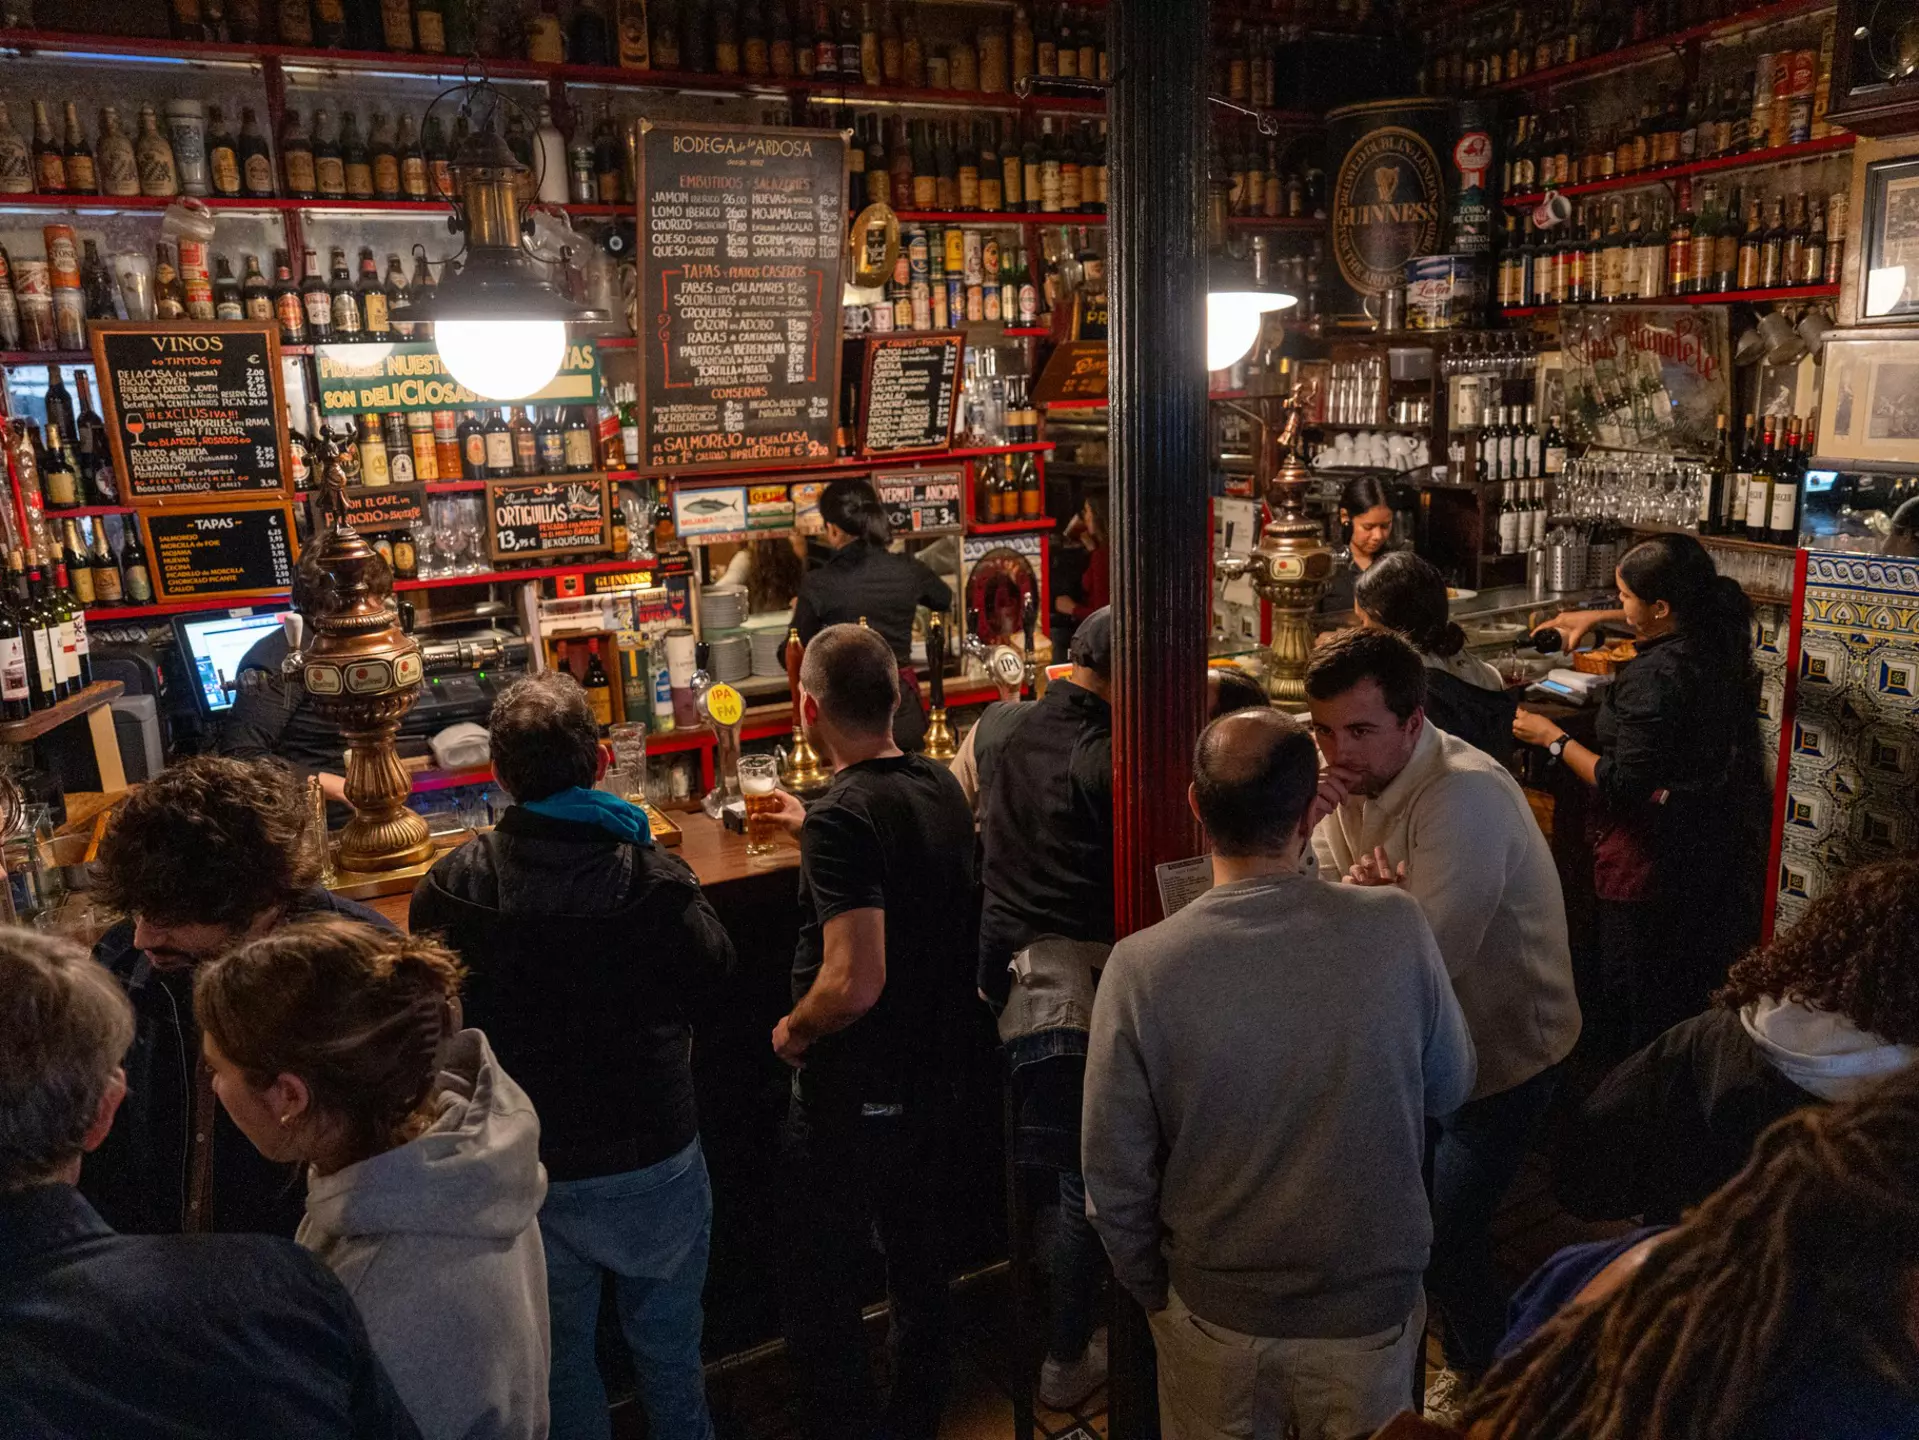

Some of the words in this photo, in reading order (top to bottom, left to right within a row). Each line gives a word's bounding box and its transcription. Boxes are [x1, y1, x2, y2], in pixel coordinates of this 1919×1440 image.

[673, 136, 737, 154] BODEGA
[755, 140, 813, 158] ARDOSA
[680, 175, 743, 189] EMBUTIDOS
[651, 192, 689, 203] JAMON
[752, 194, 786, 204] HUEVAS
[652, 206, 682, 217] LOMO
[686, 207, 720, 218] IBERICO
[752, 208, 792, 220] MOJAMA
[1340, 201, 1439, 226] GUINNESS
[1459, 205, 1484, 214] LOMO
[651, 219, 692, 231] CHORIZO
[781, 223, 813, 232] BACALAO
[652, 234, 686, 245] QUESO
[687, 236, 719, 245] CURADO
[753, 235, 785, 246] CECINA
[652, 245, 687, 257] QUESO
[753, 247, 785, 257] JAMON
[792, 247, 816, 258] PATO
[681, 264, 720, 279] TAPAS
[729, 267, 759, 278] PLATOS
[761, 265, 806, 278] CASEROS
[681, 282, 713, 294] FABES
[731, 282, 784, 294] CALAMARES
[674, 294, 737, 306] SOLOMILLITOS
[680, 307, 732, 319] CROQUETAS
[694, 319, 728, 331] CAZON
[739, 319, 774, 331] ADOBO
[152, 336, 224, 352] VINOS
[687, 332, 727, 344] RABAS
[738, 332, 783, 342] CANTABRIA
[680, 345, 722, 357] PALITOS
[733, 343, 786, 356] BERENJENA
[165, 356, 208, 366] TINTOS
[247, 354, 260, 364] €
[690, 356, 735, 367] BRANDADA
[743, 355, 775, 364] BACALAO
[144, 369, 173, 379] CASA
[698, 365, 737, 377] TORTILLA
[742, 364, 768, 374] PATATA
[119, 377, 150, 387] RIOJA
[154, 377, 187, 386] JOVEN
[694, 376, 738, 386] EMPANADA
[746, 374, 772, 384] BONITO
[163, 385, 190, 393] DUERO
[711, 386, 768, 399] CONSERVAS
[123, 401, 154, 409] Botella
[166, 399, 218, 407] CENTENARIOS
[324, 391, 357, 409] SON
[670, 404, 693, 413] BONITO
[758, 408, 797, 418] NAVAJAS
[658, 411, 716, 423] BERBERECHOS
[146, 421, 188, 429] TENEMOS
[189, 418, 233, 428] MORILES
[245, 418, 270, 427] RAMA
[653, 423, 700, 433] MEJILLONES
[174, 427, 195, 436] SIN
[198, 427, 246, 436] FILTRAR
[202, 437, 239, 445] ROSADOS
[664, 432, 742, 452] SALMOREJO
[780, 431, 808, 444] CASA
[130, 449, 167, 458] BLANCO
[178, 447, 208, 456] RUEDA
[653, 455, 664, 466] ES
[793, 444, 804, 456] €
[132, 456, 169, 465] ROSADO
[136, 485, 172, 493] BODEGAS
[174, 482, 210, 491] HIDALGO
[879, 486, 915, 504] VERMUT
[365, 497, 375, 508] EL
[496, 502, 567, 527] ORTIGUILLAS
[195, 518, 234, 530] TAPAS
[269, 516, 277, 525] €
[159, 534, 198, 542] SALMOREJO
[529, 537, 537, 547] €
[166, 570, 201, 578] PICADILLO
[595, 571, 652, 587] GUINNESS
[168, 577, 208, 586] CHORICILLO
[209, 575, 237, 583] PICANTE
[169, 585, 195, 593] CALLOS
[1000, 658, 1019, 672] IPA
[711, 688, 732, 700] IPA
[716, 700, 737, 716] FM
